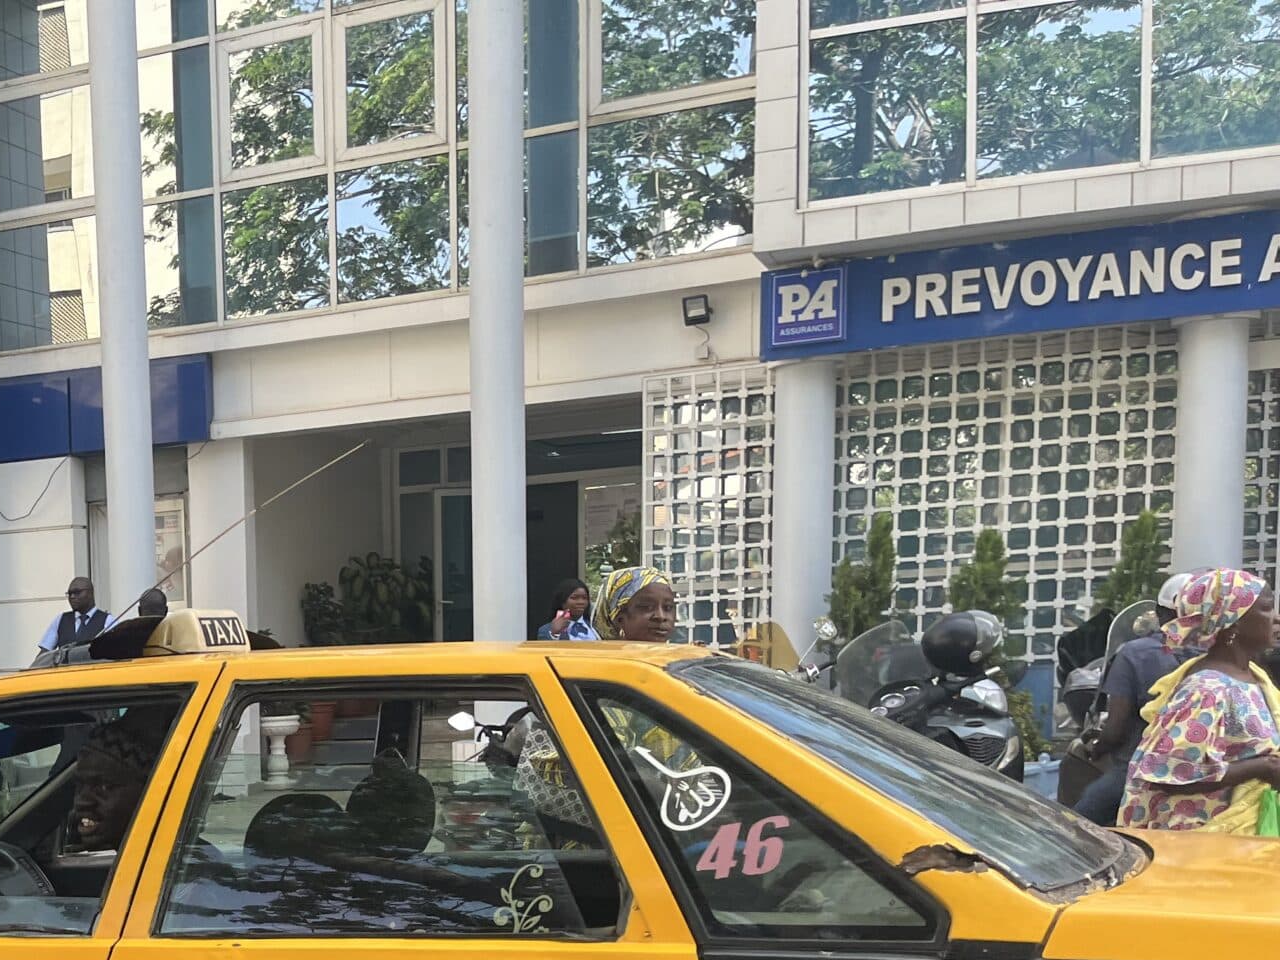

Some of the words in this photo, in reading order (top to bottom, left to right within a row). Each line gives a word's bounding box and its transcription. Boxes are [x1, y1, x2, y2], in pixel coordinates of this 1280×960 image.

[777, 279, 838, 324] PA
[881, 237, 1243, 323] PREVOYANCE
[780, 322, 834, 336] ASSURANCES
[201, 619, 244, 645] TAXI
[696, 815, 790, 880] 46
